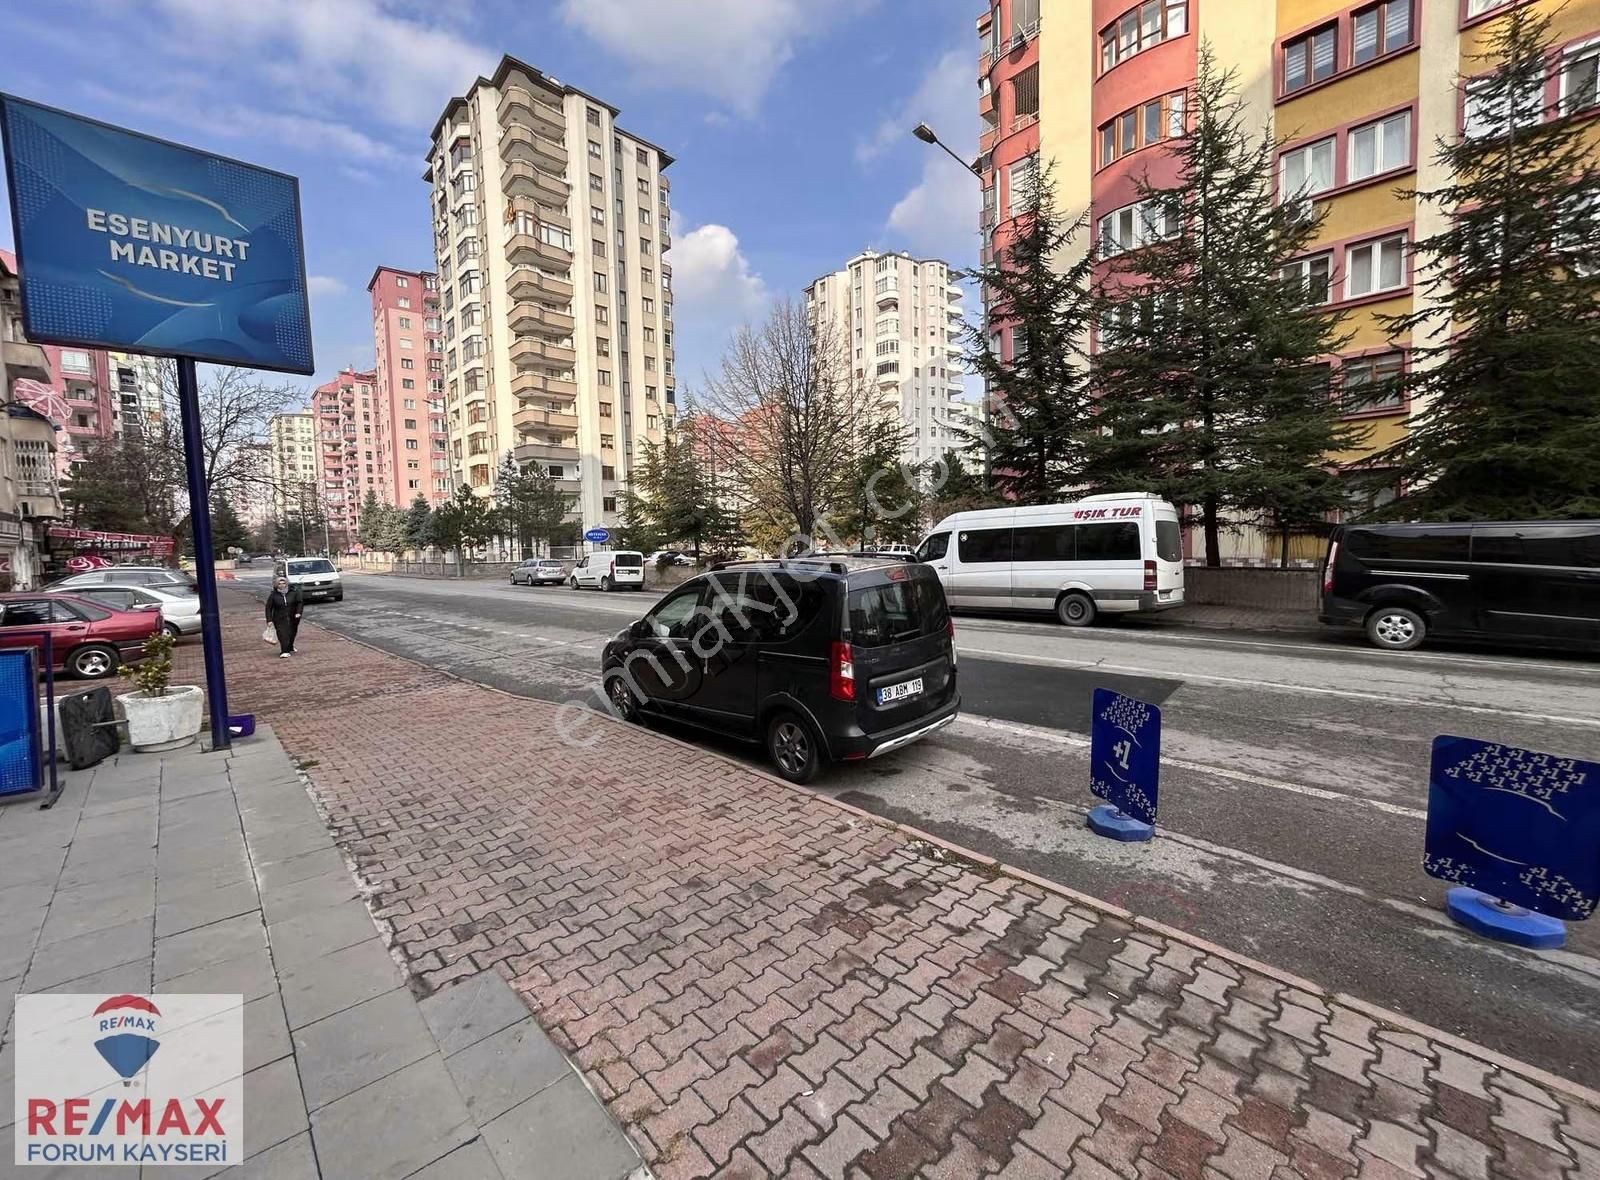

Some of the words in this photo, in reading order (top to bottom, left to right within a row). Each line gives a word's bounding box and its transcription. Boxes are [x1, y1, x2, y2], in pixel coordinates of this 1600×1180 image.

[86, 208, 250, 261] ESENYURT
[109, 240, 236, 282] MARKET
[1112, 506, 1142, 517] TUR
[882, 687, 892, 700] 38
[895, 683, 909, 697] ABM
[911, 679, 922, 692] 119
[1113, 740, 1131, 770] +1
